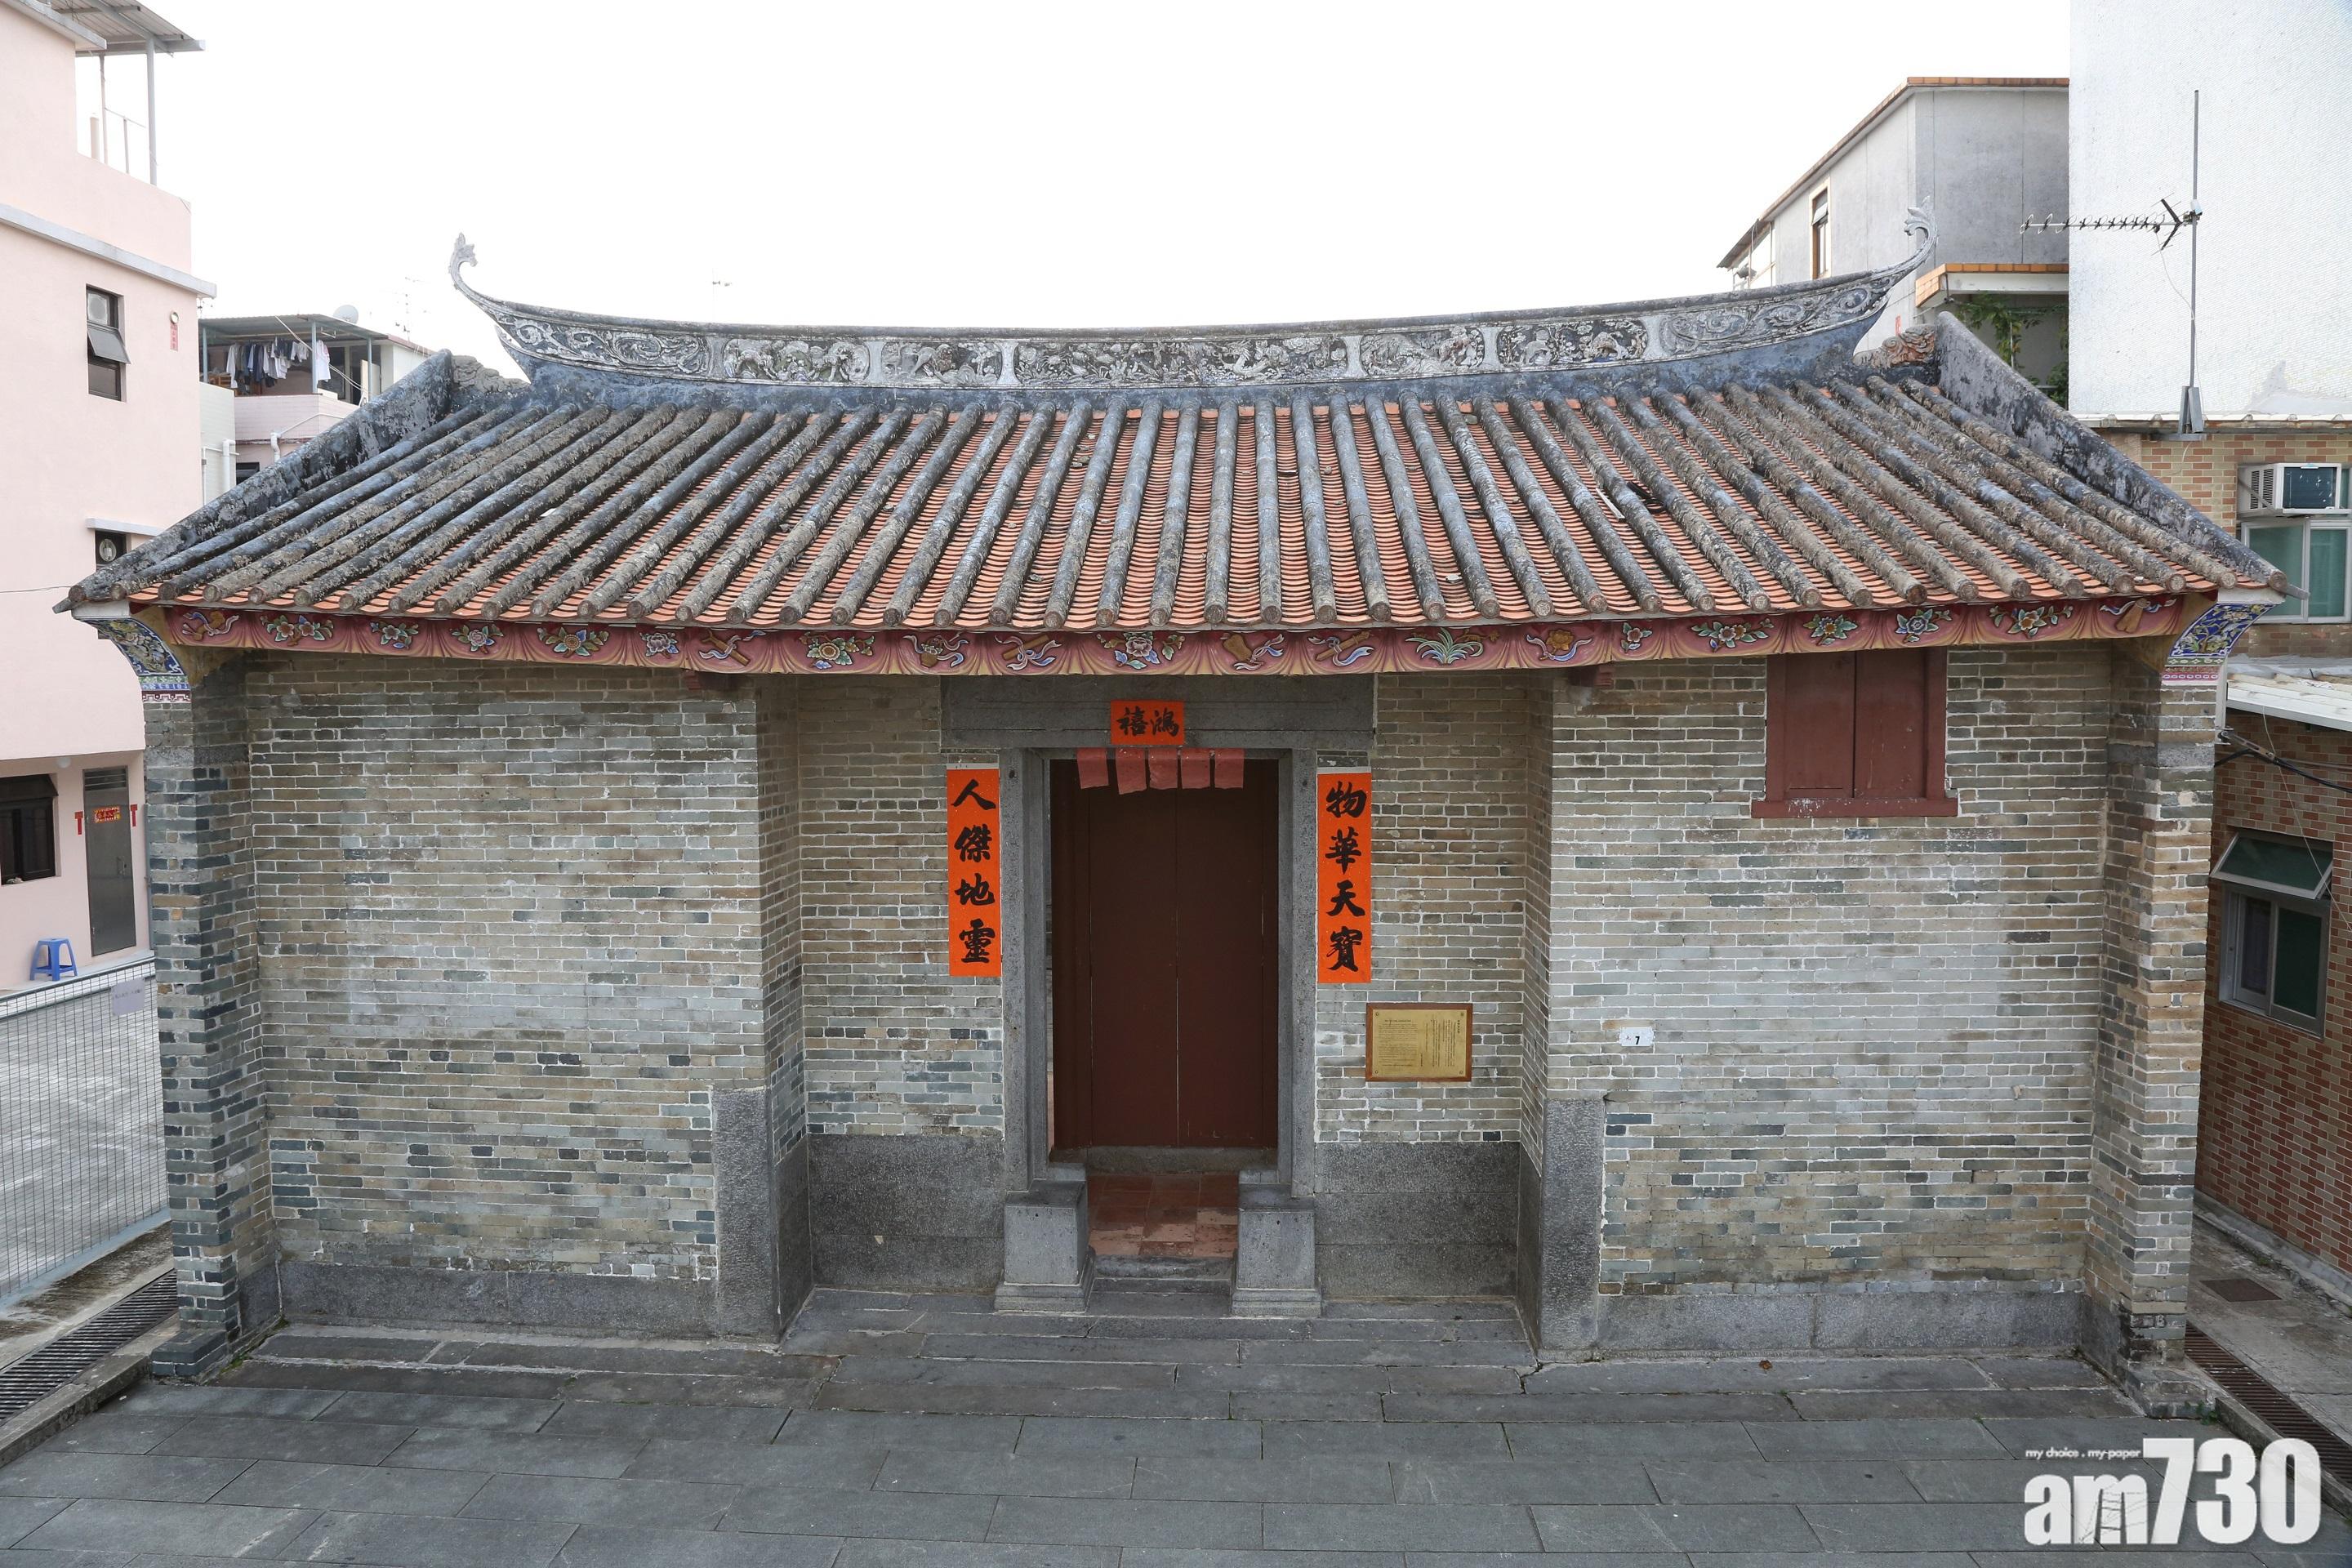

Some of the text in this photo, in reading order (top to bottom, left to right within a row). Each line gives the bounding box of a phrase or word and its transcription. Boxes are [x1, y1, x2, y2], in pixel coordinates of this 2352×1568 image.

[952, 778, 997, 964] 人傑地靈
[1325, 781, 1368, 972] 物華天寶
[1635, 1036, 1640, 1045] 7
